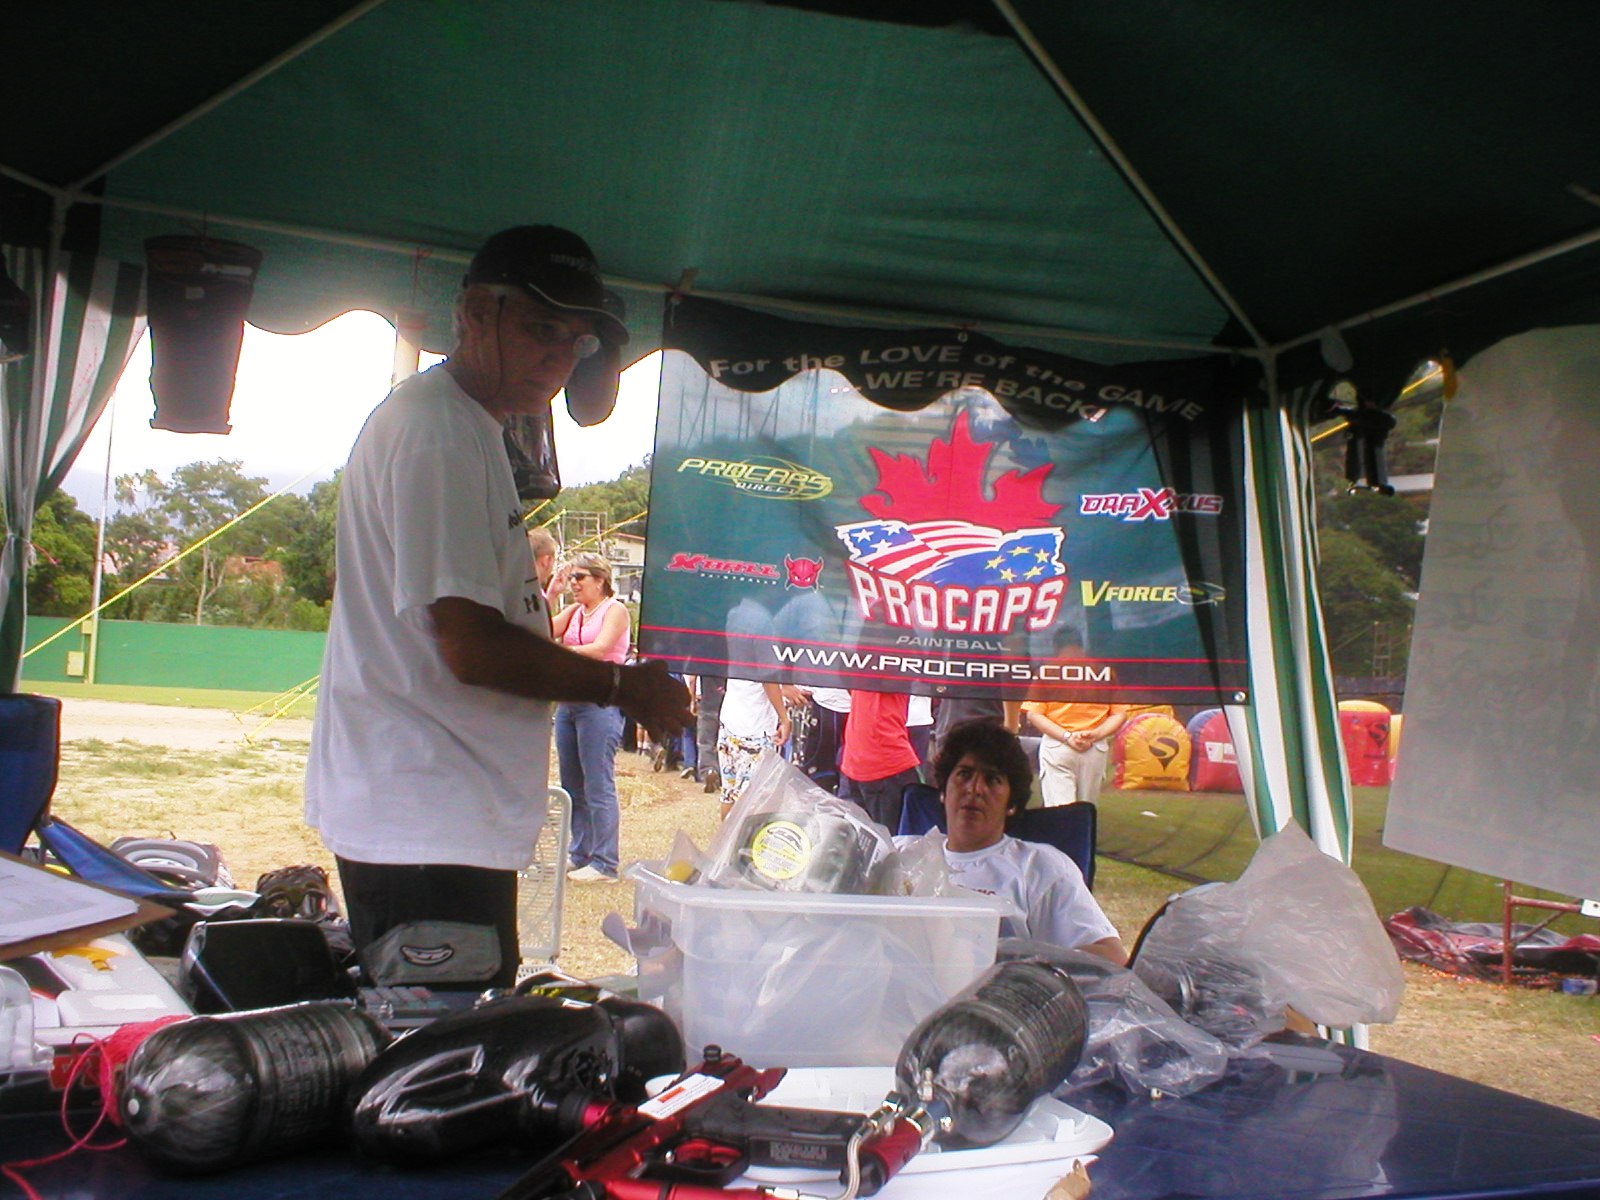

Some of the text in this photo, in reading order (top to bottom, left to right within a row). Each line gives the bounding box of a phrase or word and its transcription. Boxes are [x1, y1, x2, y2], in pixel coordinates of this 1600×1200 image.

[709, 345, 1203, 421] For the LOVE of the GAME
[994, 377, 1106, 422] BACK!
[676, 457, 830, 490] PROCAPS
[847, 562, 1067, 634] PROCAPS
[772, 644, 1112, 682] WWW.PROCAPS.COM
[895, 634, 1009, 651] PAINTBALL
